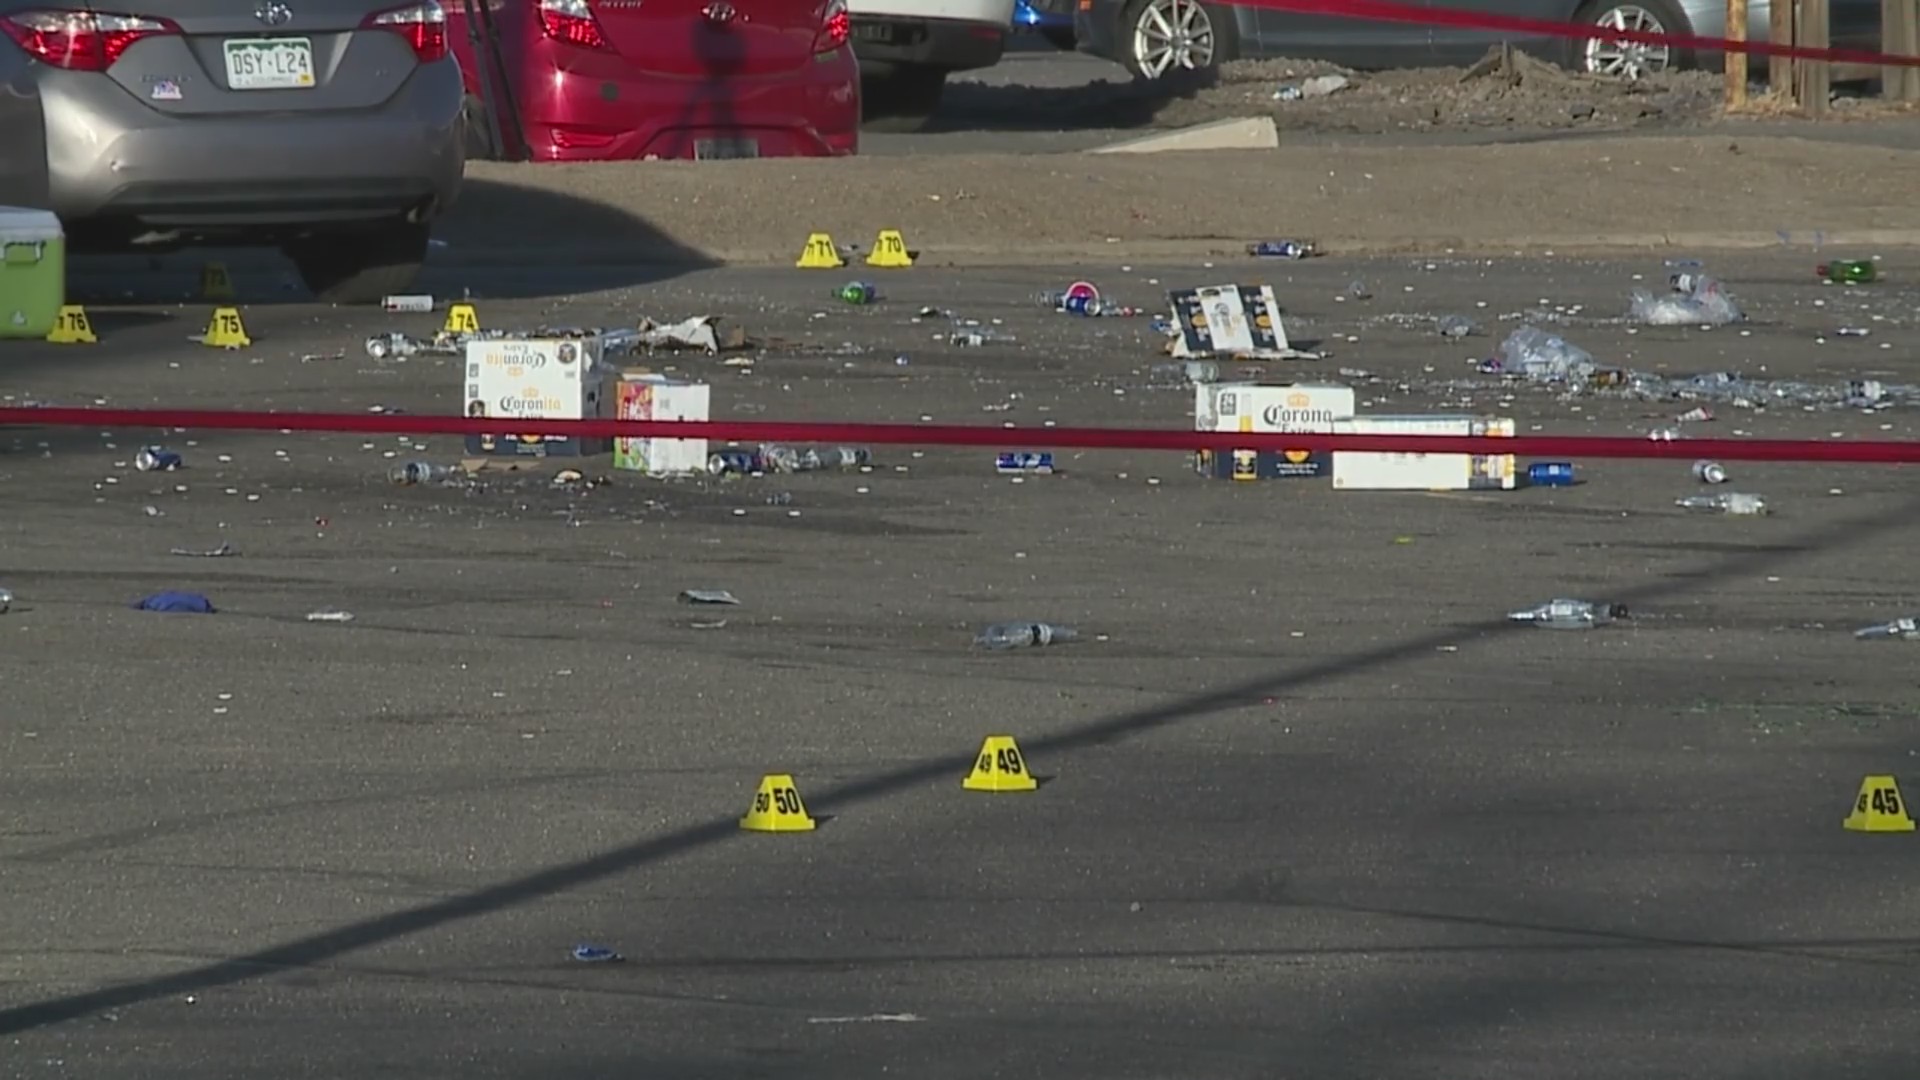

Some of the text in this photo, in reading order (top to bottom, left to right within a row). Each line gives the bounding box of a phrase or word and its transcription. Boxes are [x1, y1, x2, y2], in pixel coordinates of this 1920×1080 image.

[815, 240, 833, 257] 71
[885, 236, 901, 253] 70
[67, 313, 86, 331] 76
[220, 315, 239, 334] 75
[456, 313, 475, 331] 74
[500, 396, 562, 414] Coronita
[1263, 404, 1332, 426] Corona
[997, 748, 1021, 775] 49
[773, 787, 800, 815] 50
[1872, 788, 1900, 815] 45
